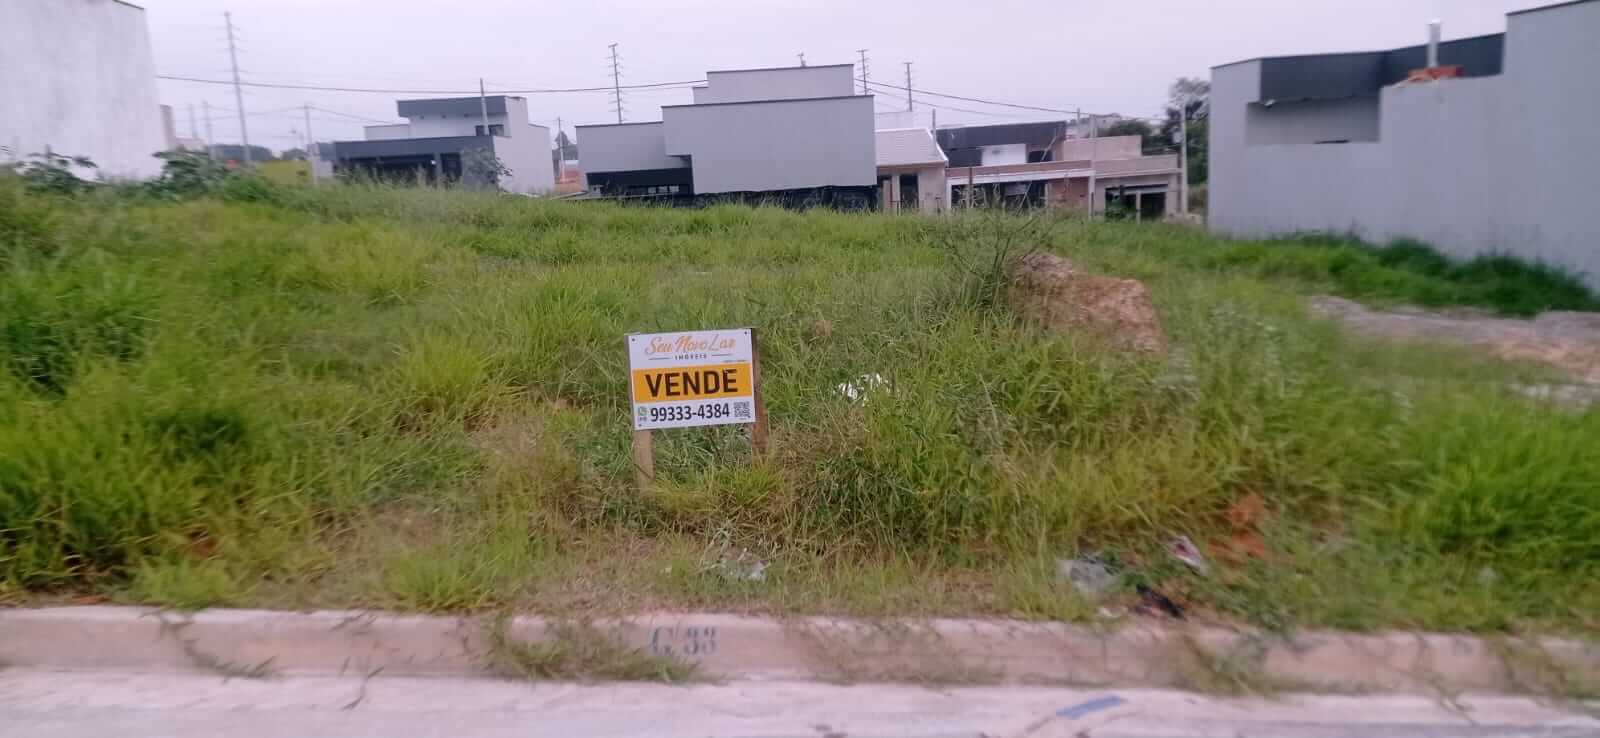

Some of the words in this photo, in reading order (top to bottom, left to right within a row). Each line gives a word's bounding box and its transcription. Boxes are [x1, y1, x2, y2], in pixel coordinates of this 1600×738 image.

[644, 336, 673, 355] Seu
[674, 335, 707, 353] Novo
[708, 333, 737, 351] Lar
[644, 369, 738, 398] VENDE
[650, 403, 730, 422] 99333-4384
